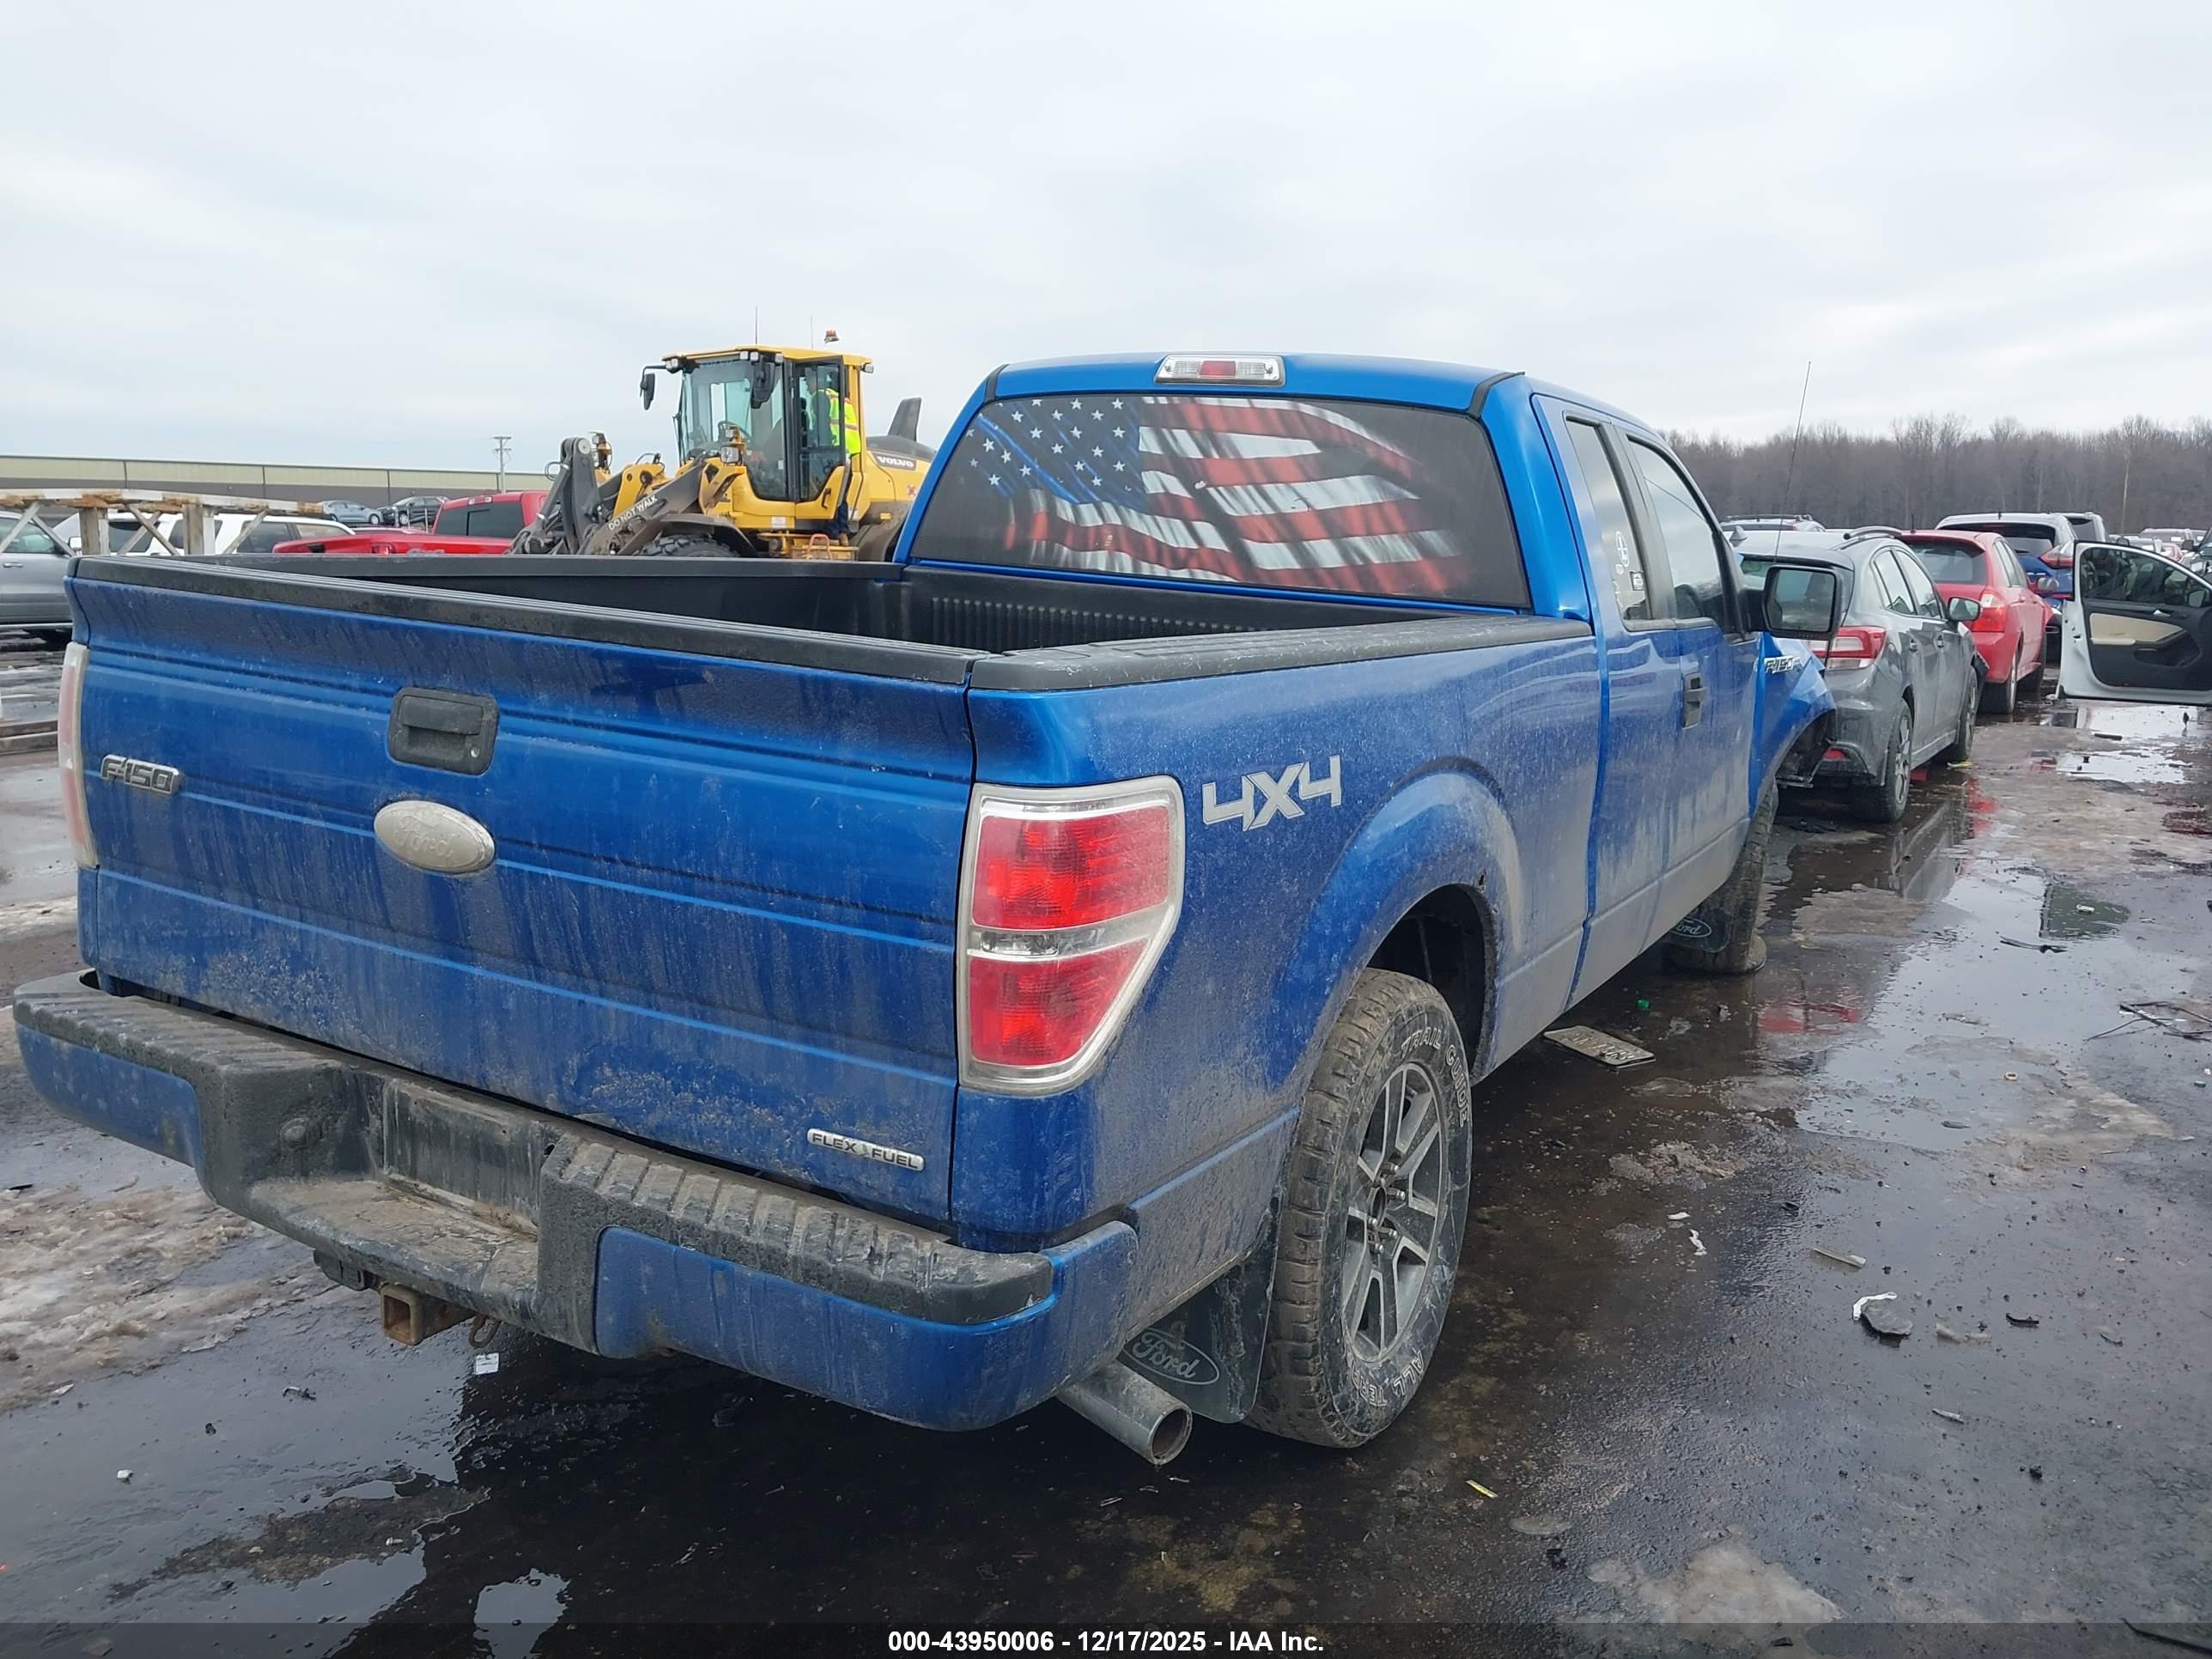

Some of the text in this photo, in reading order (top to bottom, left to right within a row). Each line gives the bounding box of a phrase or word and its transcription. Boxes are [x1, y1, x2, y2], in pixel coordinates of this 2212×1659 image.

[877, 456, 914, 467] VOLVO
[620, 507, 636, 523] NOT
[636, 494, 659, 512] WALK
[393, 815, 454, 858] Ford
[1401, 1027, 1470, 1127] TRAIL GUIDE
[811, 1132, 918, 1169] FLEX FUEL
[1133, 1332, 1200, 1378] Ford
[1393, 1348, 1425, 1396] ALL
